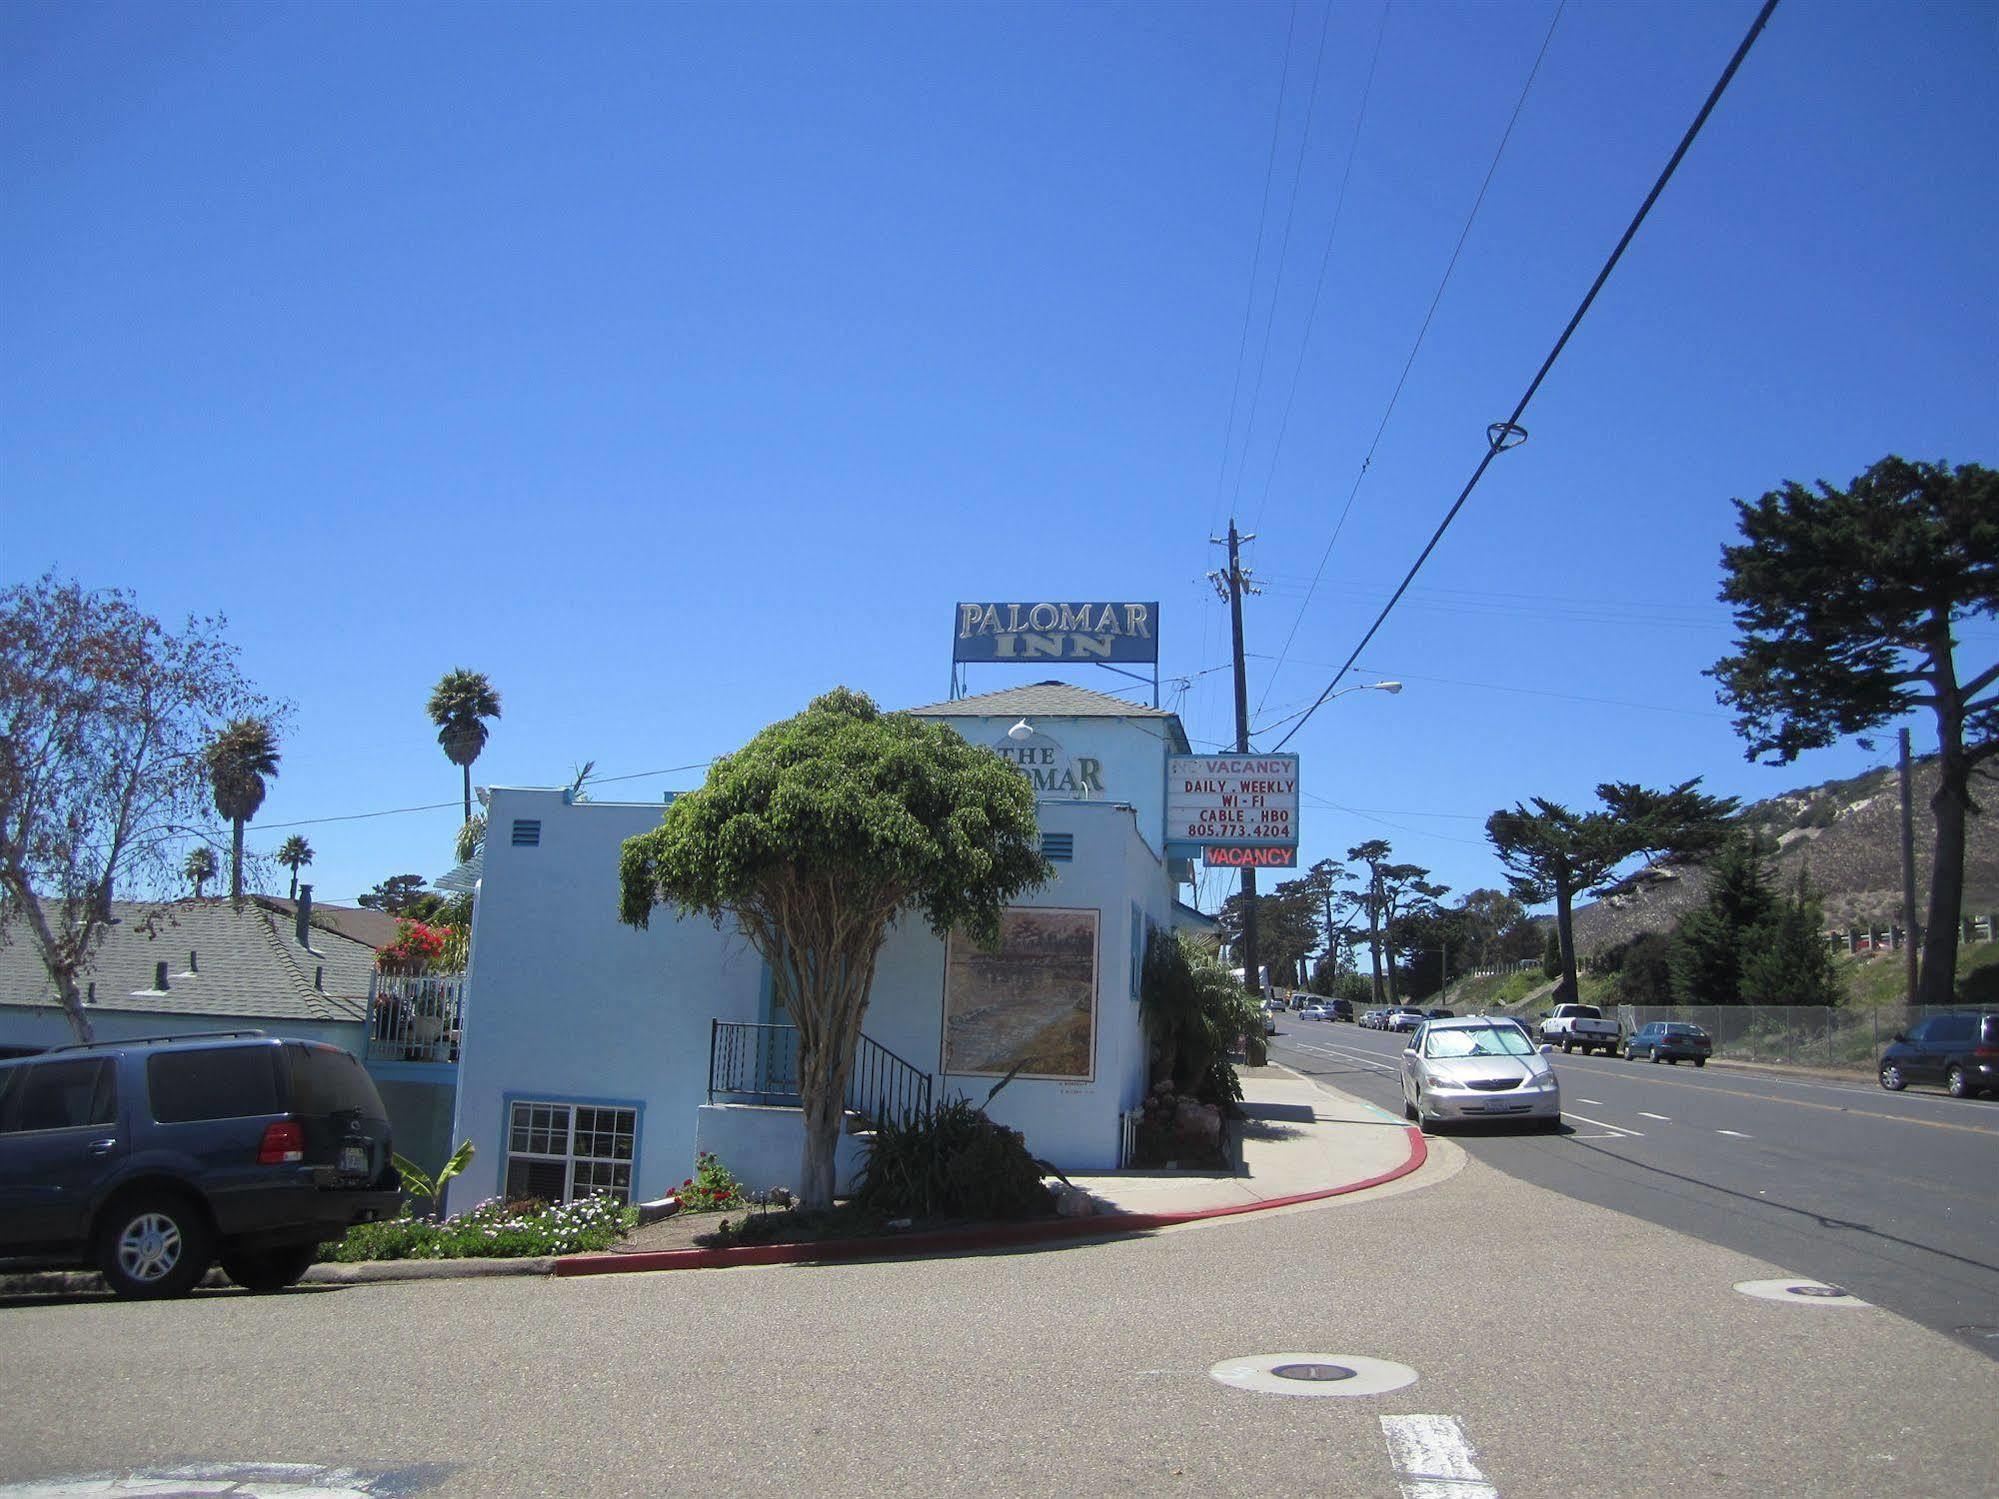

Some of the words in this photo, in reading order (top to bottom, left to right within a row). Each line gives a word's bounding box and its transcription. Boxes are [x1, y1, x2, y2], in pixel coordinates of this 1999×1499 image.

[960, 603, 1151, 639] PALOMAR
[994, 633, 1116, 657] INN
[998, 748, 1055, 764] THE
[1206, 760, 1291, 773] VACANCY
[1185, 781, 1226, 793] DAILY
[1240, 781, 1294, 793] WEEKLY
[1200, 810, 1243, 822] CABLE
[1261, 810, 1289, 822] HBO
[1188, 824, 1290, 837] 805.773.4204
[1207, 847, 1293, 866] VACANCY
